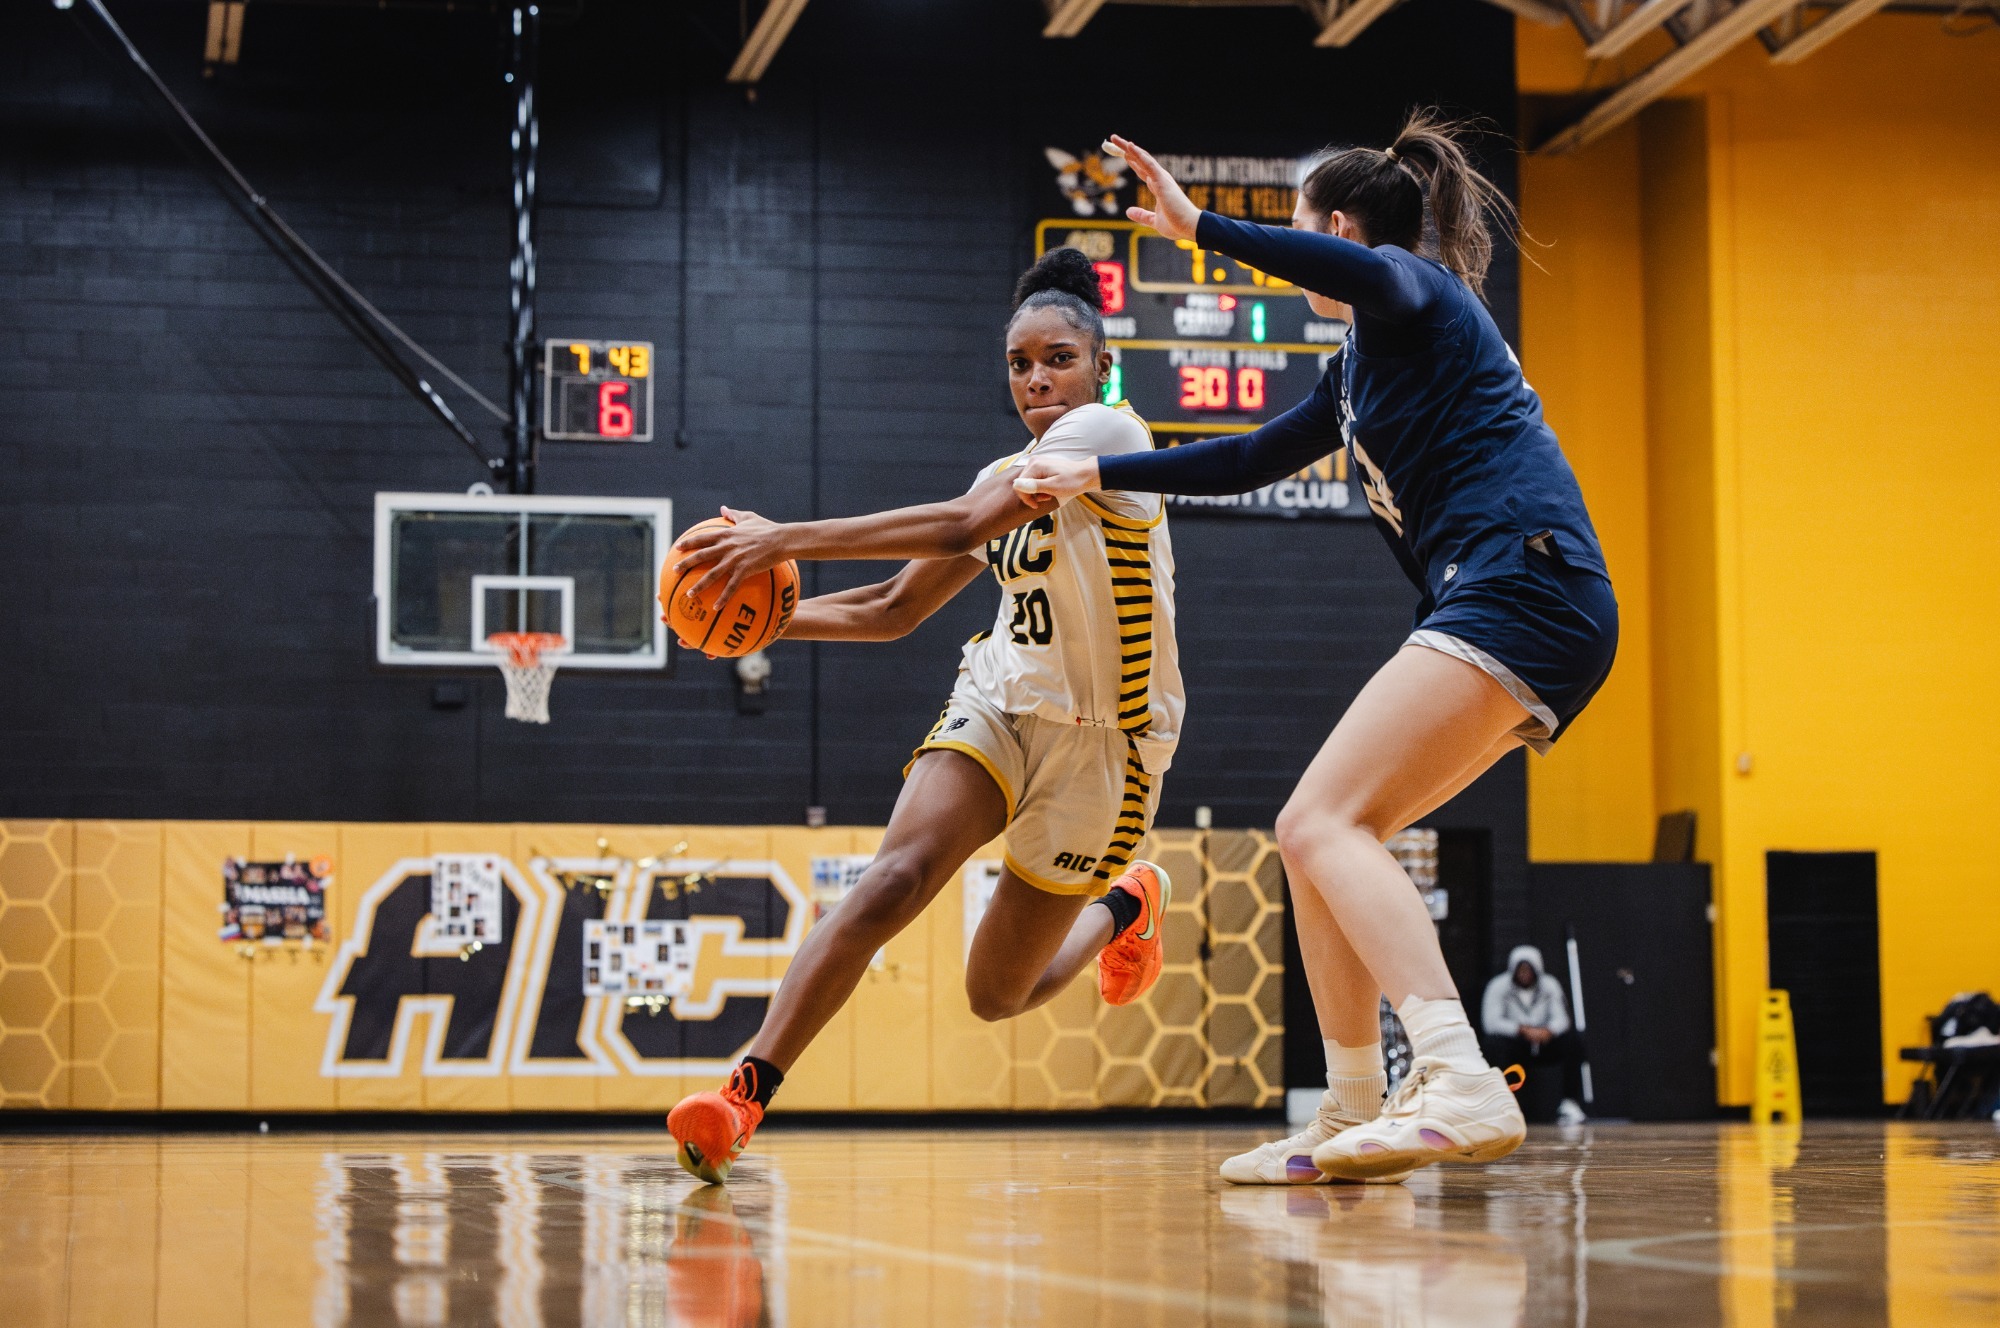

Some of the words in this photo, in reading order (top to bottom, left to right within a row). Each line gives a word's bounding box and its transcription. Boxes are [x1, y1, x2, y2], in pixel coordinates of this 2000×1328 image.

[1251, 302, 1267, 343] 1
[569, 343, 591, 375] 7
[608, 345, 650, 378] 43
[599, 381, 634, 437] 6
[1179, 366, 1229, 410] 30
[1237, 367, 1265, 410] 0
[1273, 481, 1350, 510] CLUB
[723, 602, 757, 651] EVO
[1052, 851, 1097, 873] AIC
[313, 856, 807, 1077] AIC
